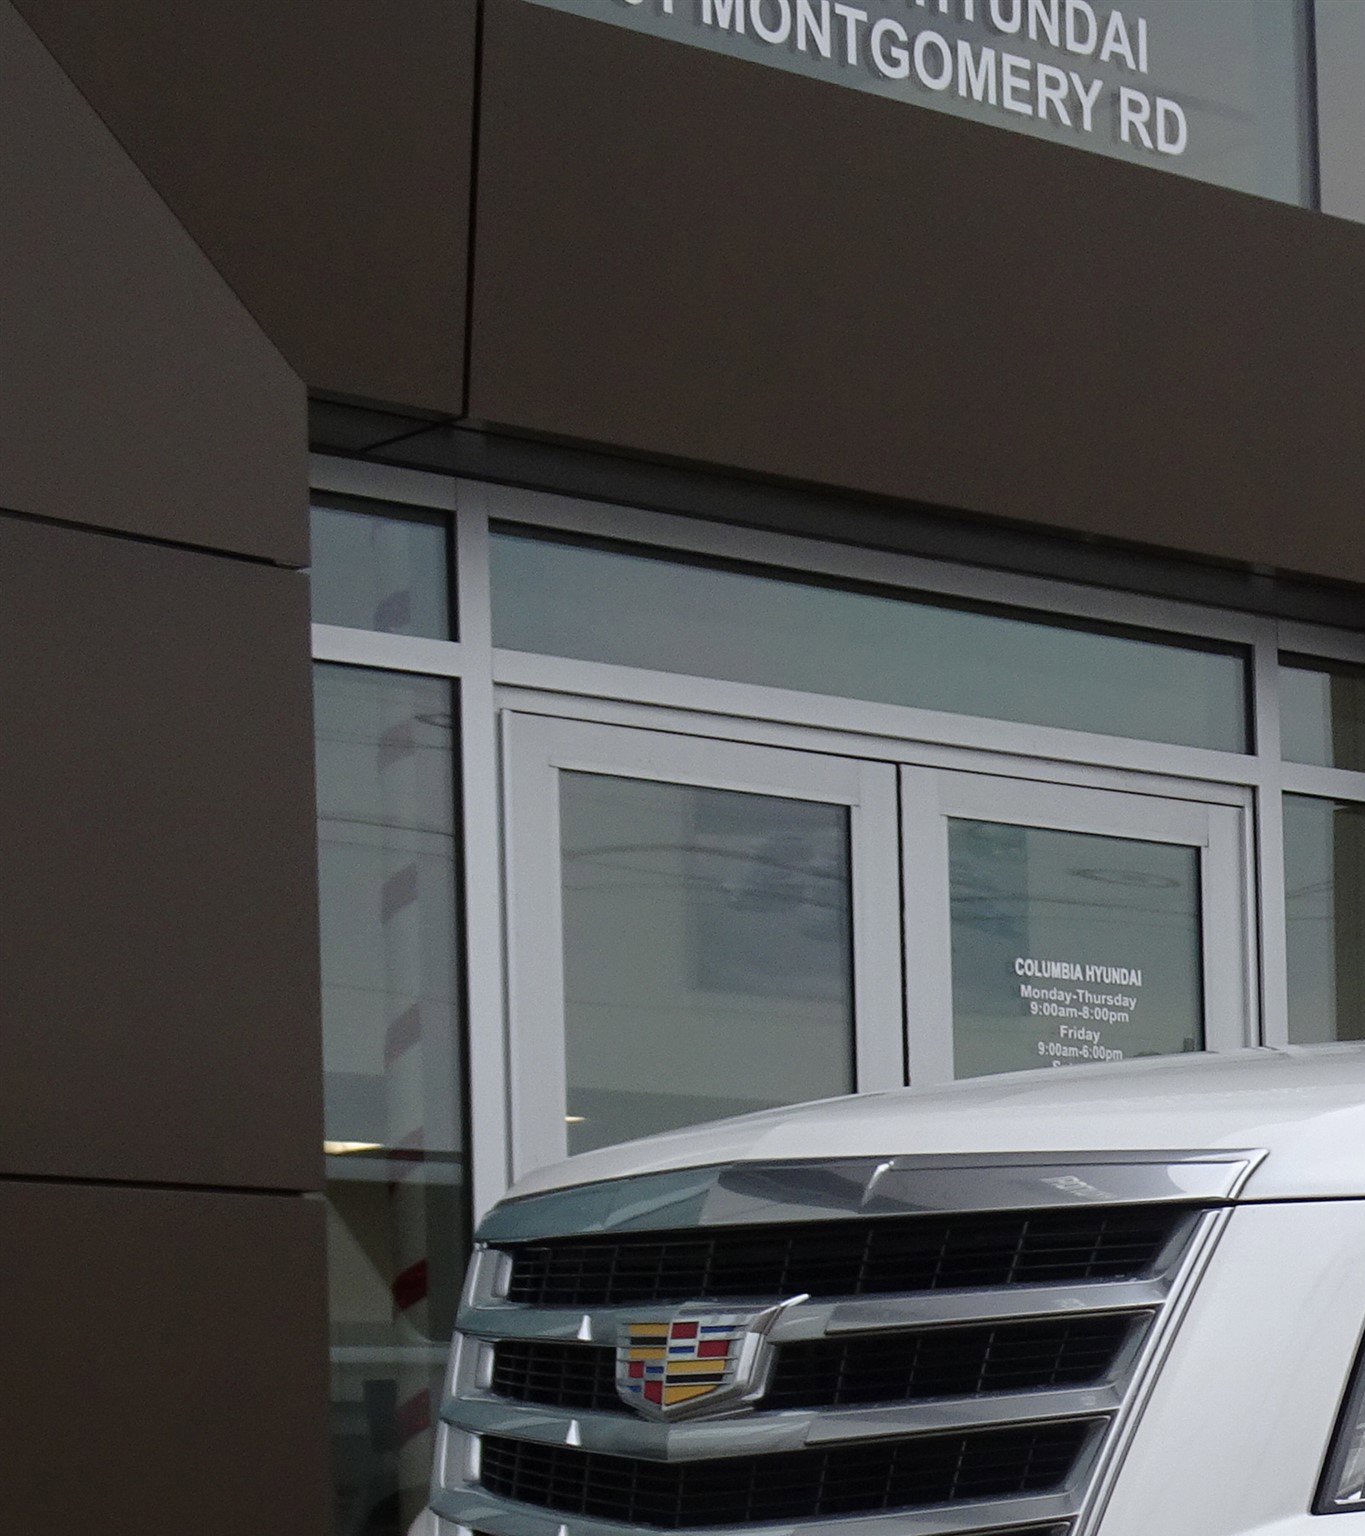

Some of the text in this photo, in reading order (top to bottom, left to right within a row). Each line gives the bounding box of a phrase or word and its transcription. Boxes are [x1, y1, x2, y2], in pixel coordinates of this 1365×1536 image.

[915, 0, 1149, 74] UNDAI
[1119, 86, 1188, 155] RD
[1015, 957, 1143, 987] COLUMBIA HYUNDAI
[1020, 984, 1138, 1010] Monday-Thursday
[1029, 1002, 1130, 1024] 9:00am-8:00pm
[1059, 1024, 1101, 1044] Friday
